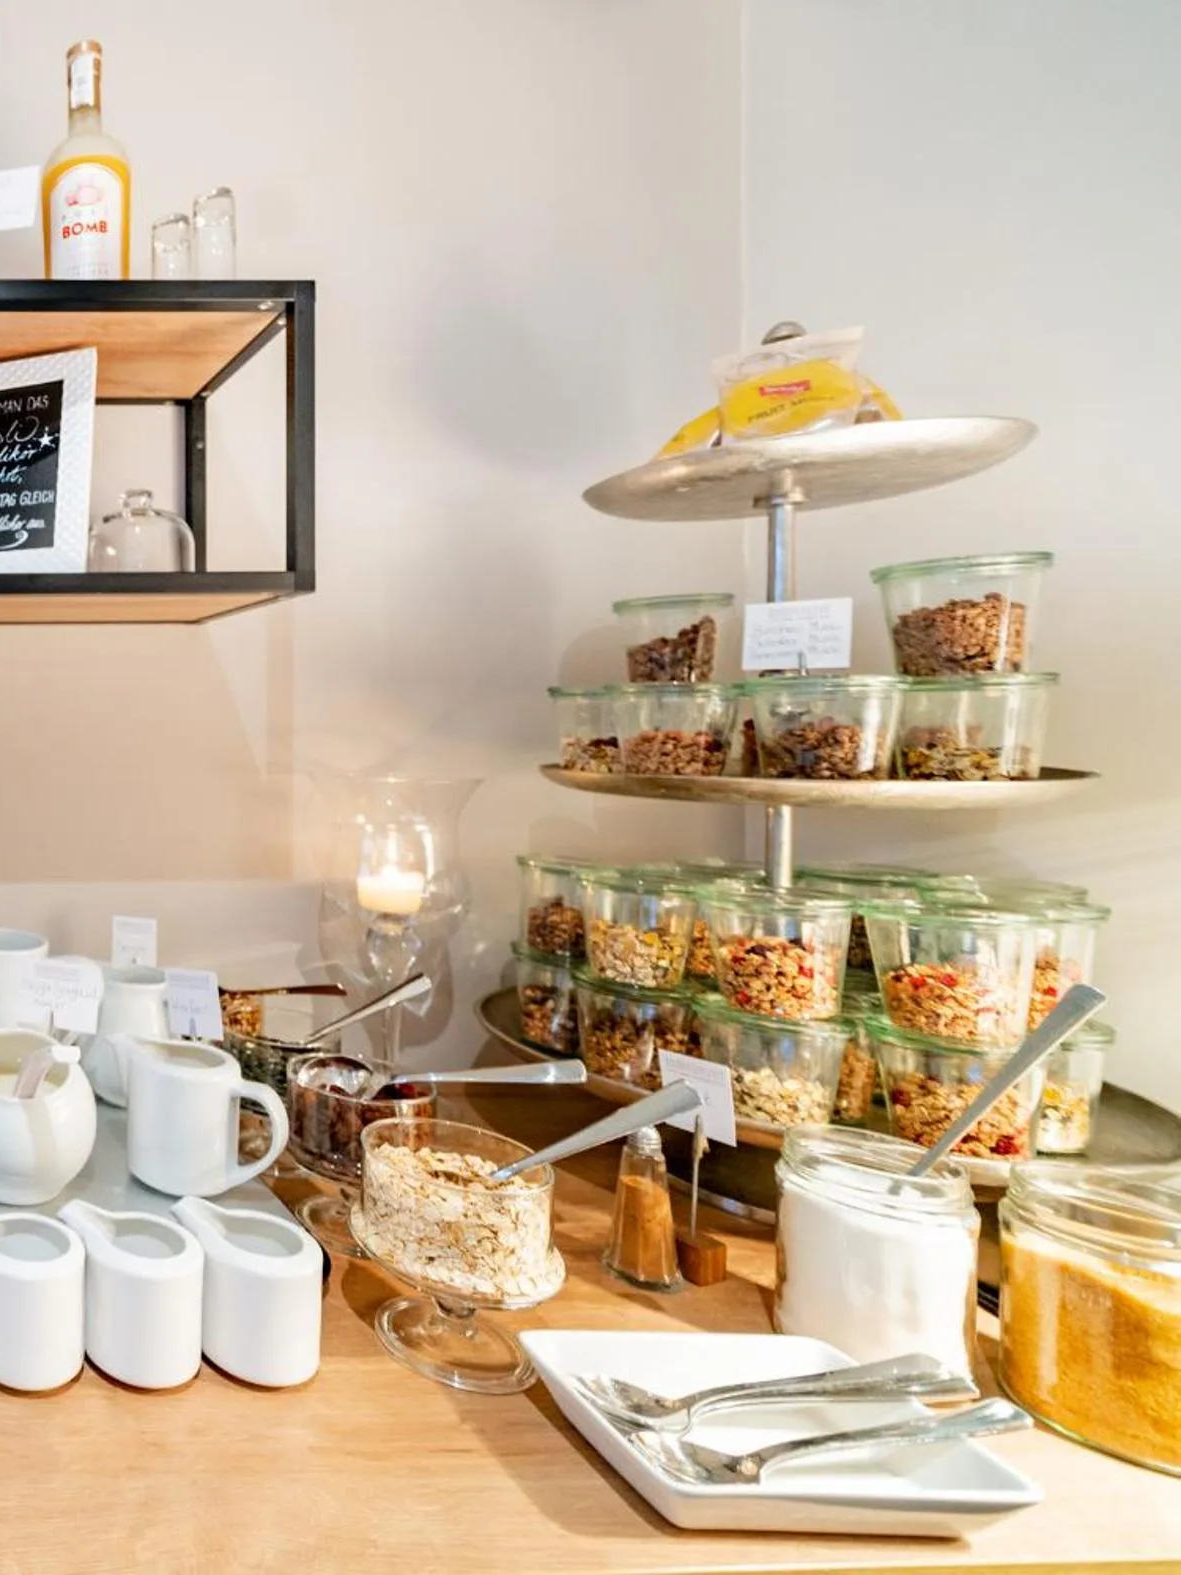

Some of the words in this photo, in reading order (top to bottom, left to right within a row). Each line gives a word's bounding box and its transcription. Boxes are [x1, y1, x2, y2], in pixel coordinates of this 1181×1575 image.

[62, 220, 108, 239] BOMB
[26, 394, 49, 411] DAS
[0, 491, 18, 508] TAG
[19, 489, 55, 506] GLEICH
